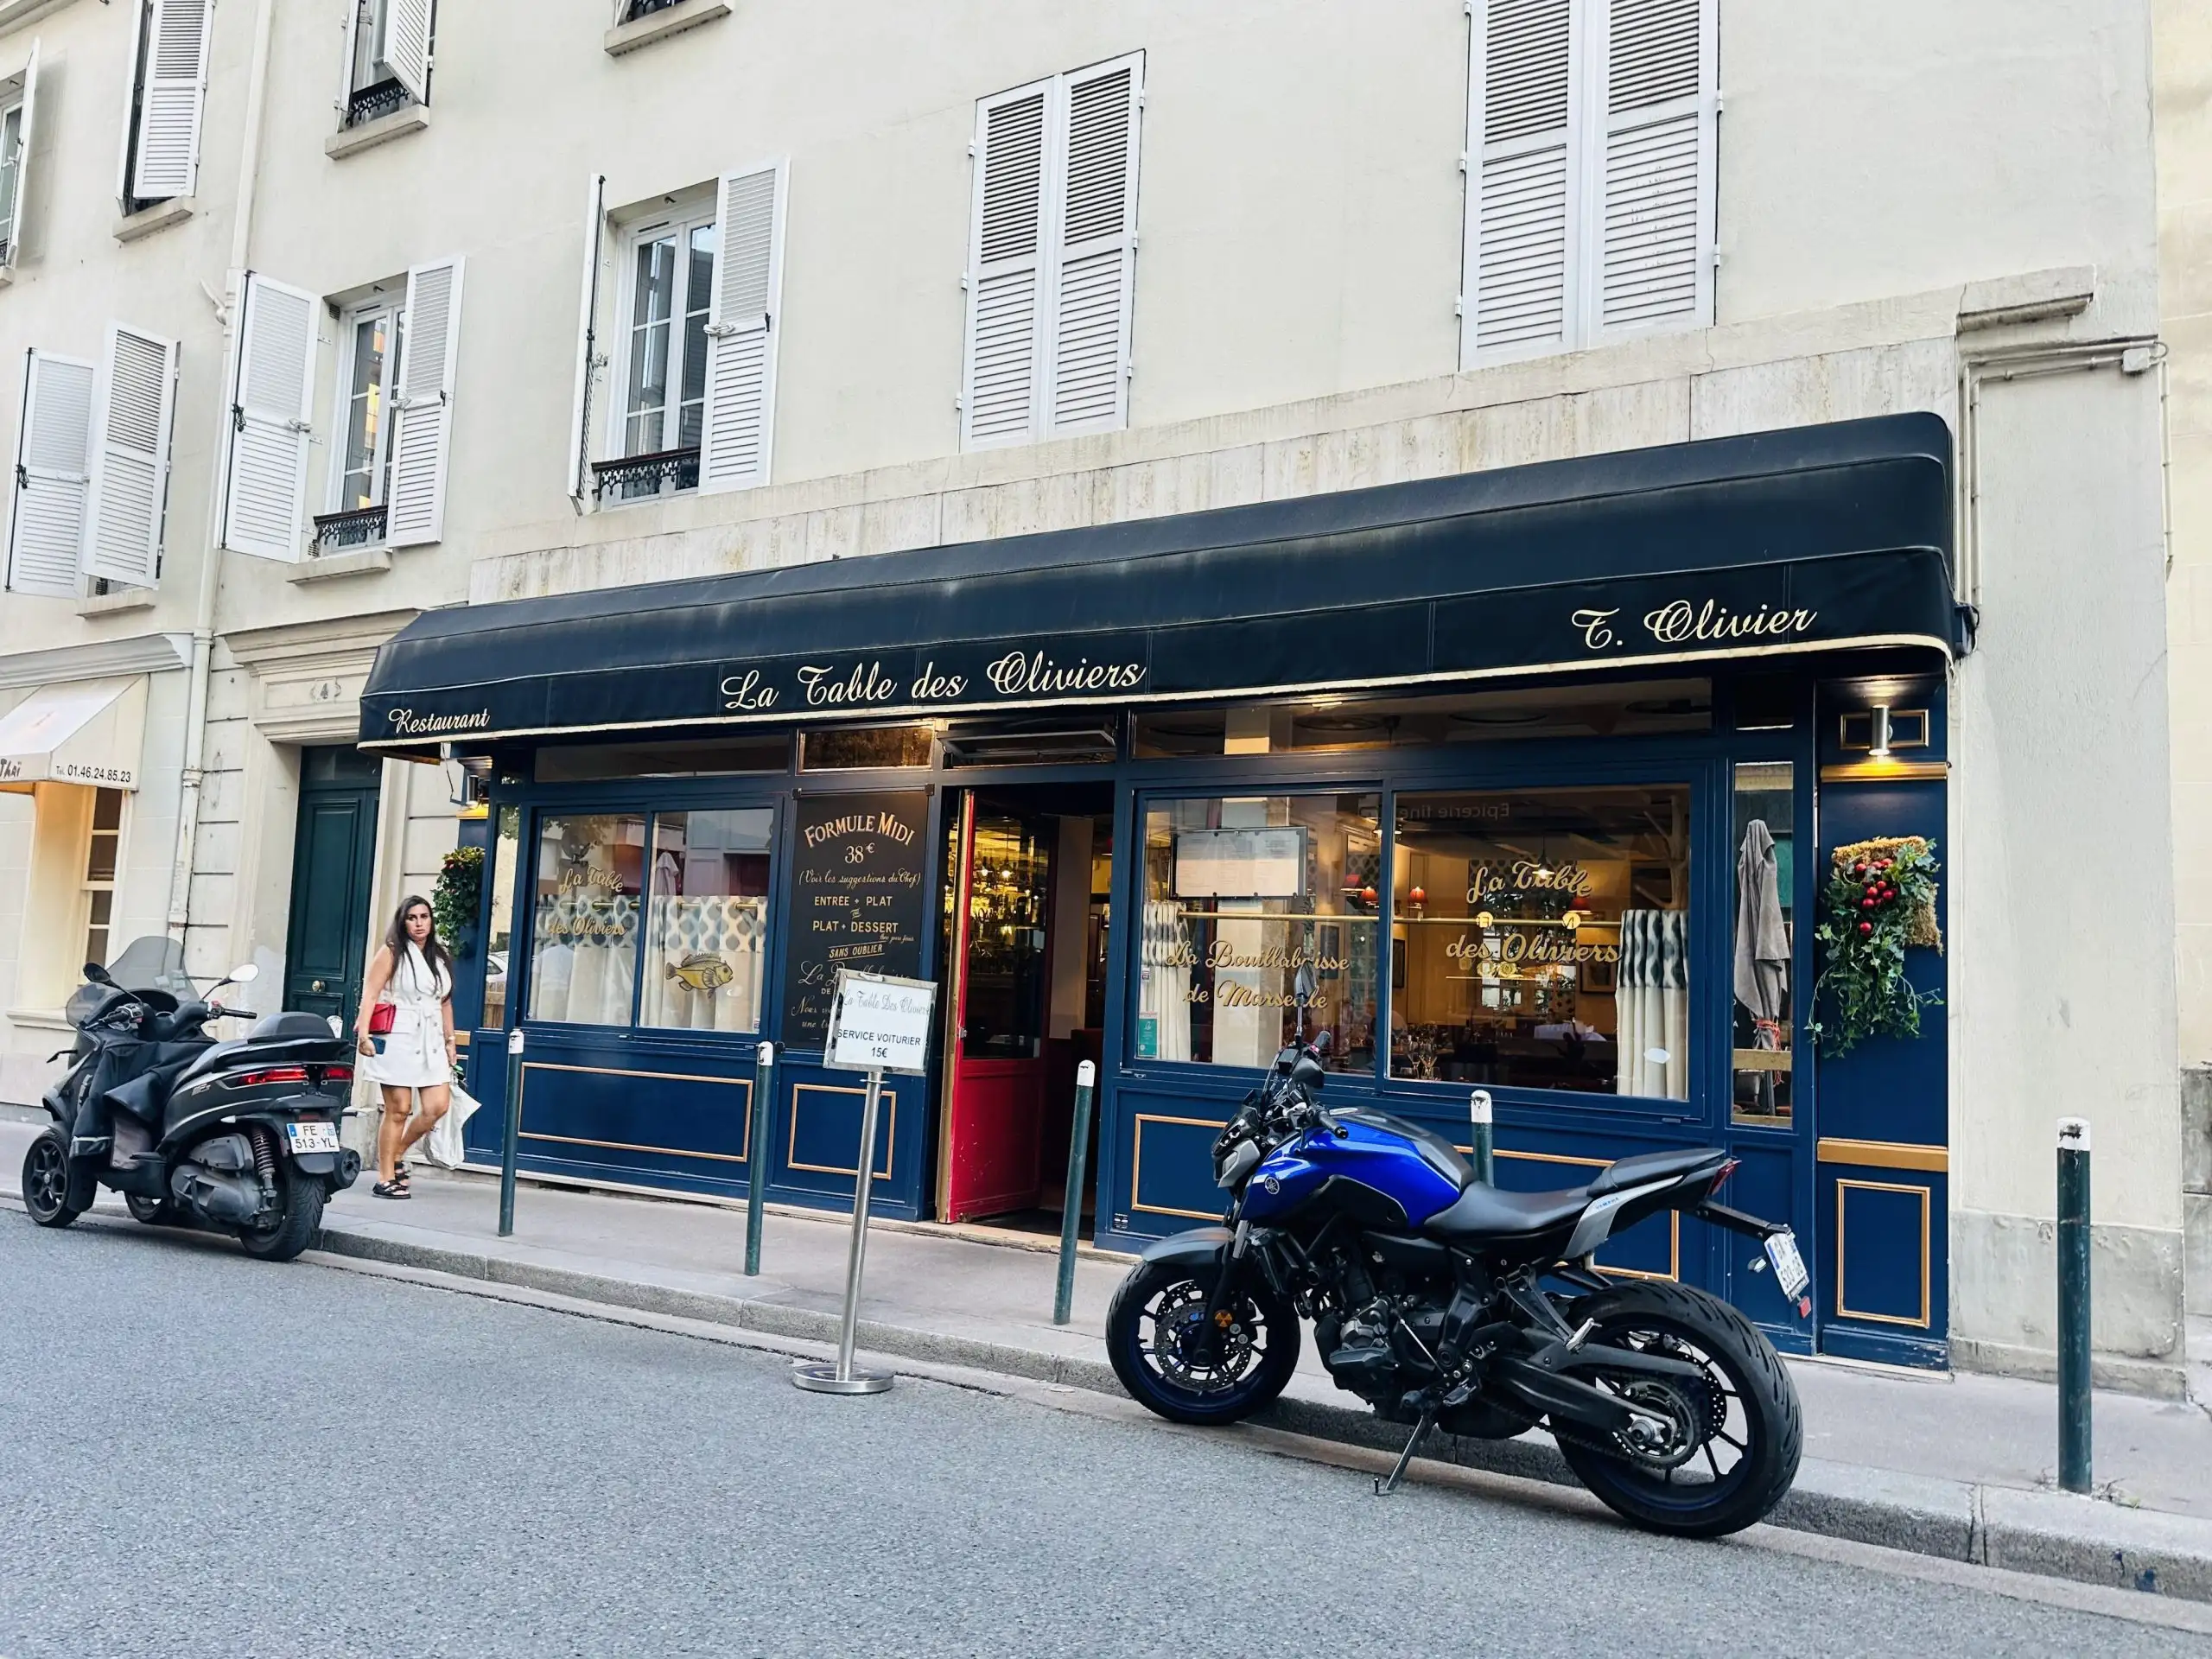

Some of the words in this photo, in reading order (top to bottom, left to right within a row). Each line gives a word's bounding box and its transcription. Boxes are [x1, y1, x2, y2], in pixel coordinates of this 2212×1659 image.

[1572, 607, 1623, 649] T.
[1643, 599, 1817, 642] Olivier
[721, 670, 779, 709] La
[798, 661, 897, 704] Table
[912, 661, 969, 699] des
[987, 651, 1147, 694] Oliviers
[389, 709, 490, 734] Restaurant
[67, 764, 131, 783] 01.46.24.85.23
[804, 815, 876, 849] FORMULE
[877, 811, 916, 846] MIDI
[844, 842, 875, 864] 38€
[559, 868, 582, 894] La
[587, 865, 623, 892] Table
[824, 868, 836, 883] les
[839, 873, 886, 889] suggestions
[1466, 867, 1506, 904] La
[866, 896, 893, 906] PLAT
[812, 920, 839, 931] PLAT
[850, 921, 899, 933] DESSERT
[829, 947, 849, 959] SANS
[852, 943, 883, 956] OUBLIER
[1166, 940, 1198, 966] La
[1446, 934, 1494, 959] des
[1503, 932, 1623, 963] Oliviers
[798, 961, 823, 985] La
[1183, 984, 1209, 1003] de
[837, 1029, 874, 1041] SERVICE
[877, 1033, 921, 1046] VOITURIER
[871, 1047, 888, 1058] 15€
[303, 1126, 318, 1135] FE
[296, 1137, 335, 1149] 513-YL
